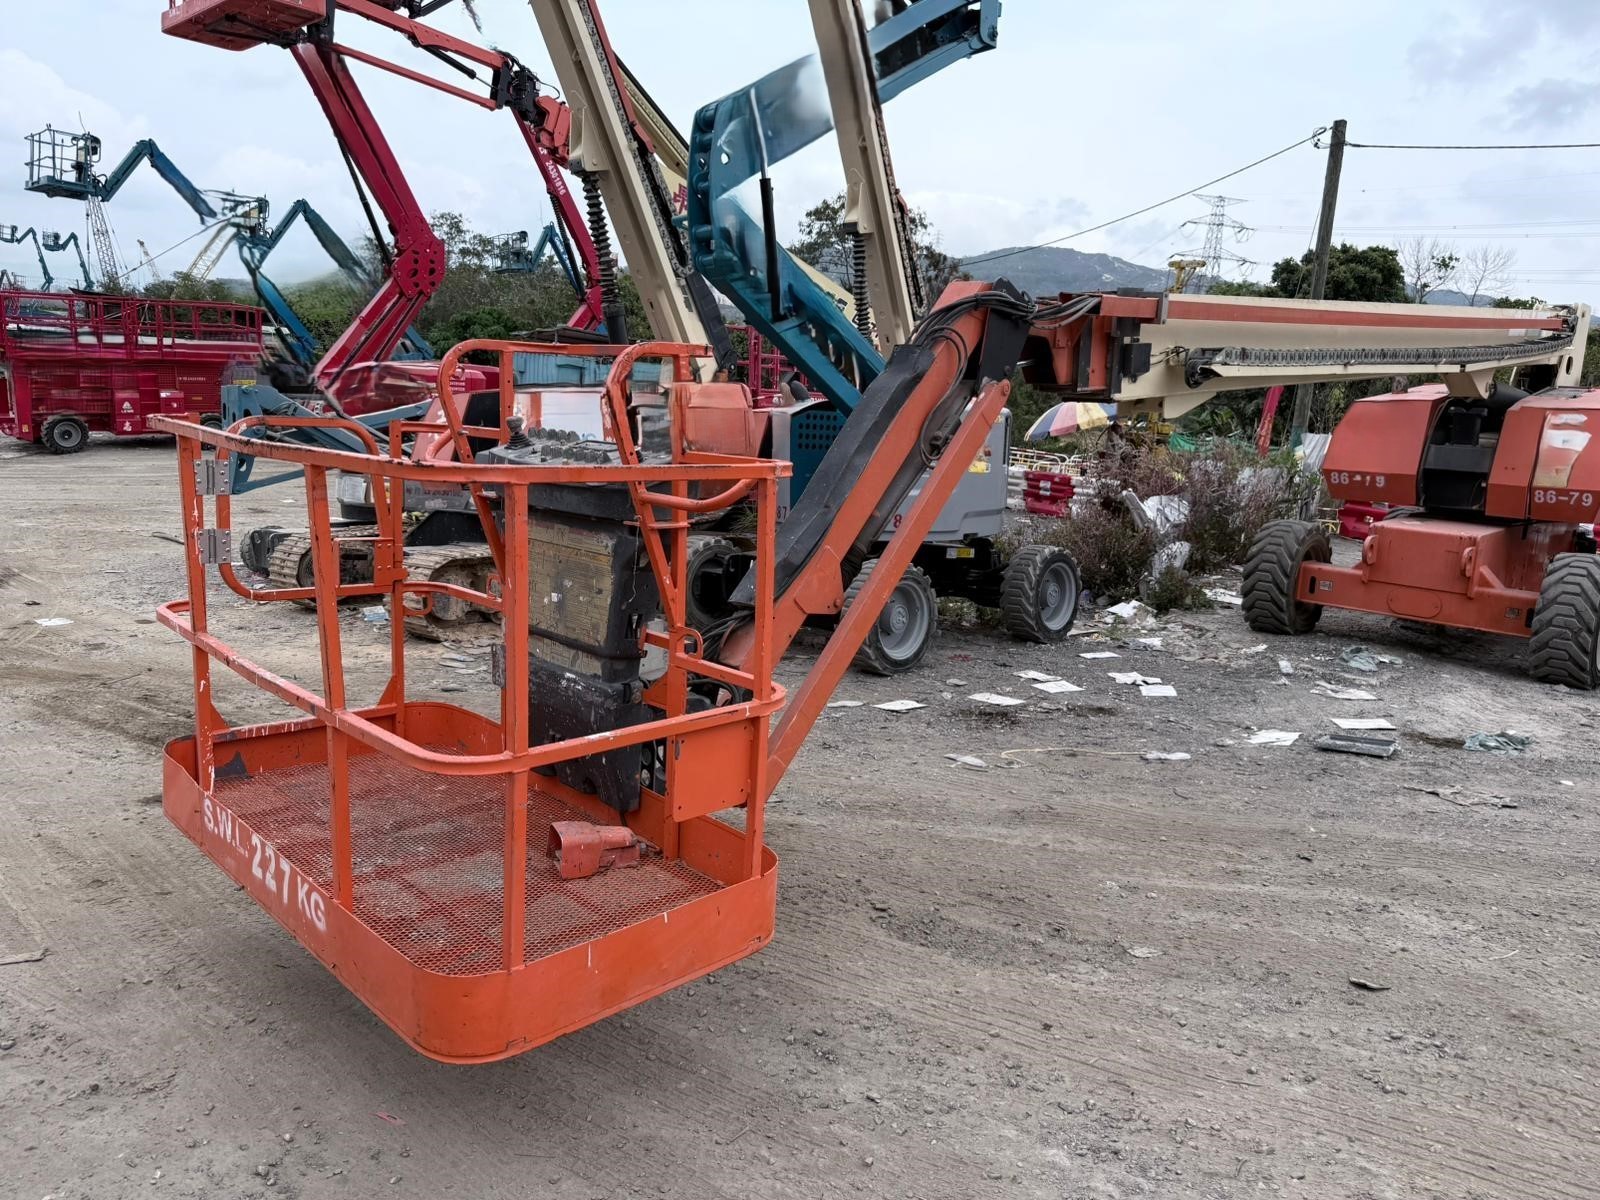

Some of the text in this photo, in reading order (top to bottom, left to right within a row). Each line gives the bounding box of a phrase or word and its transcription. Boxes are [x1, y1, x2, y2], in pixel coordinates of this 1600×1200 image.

[1534, 490, 1593, 507] 86-79
[251, 833, 291, 904] 227
[297, 874, 327, 932] KG
